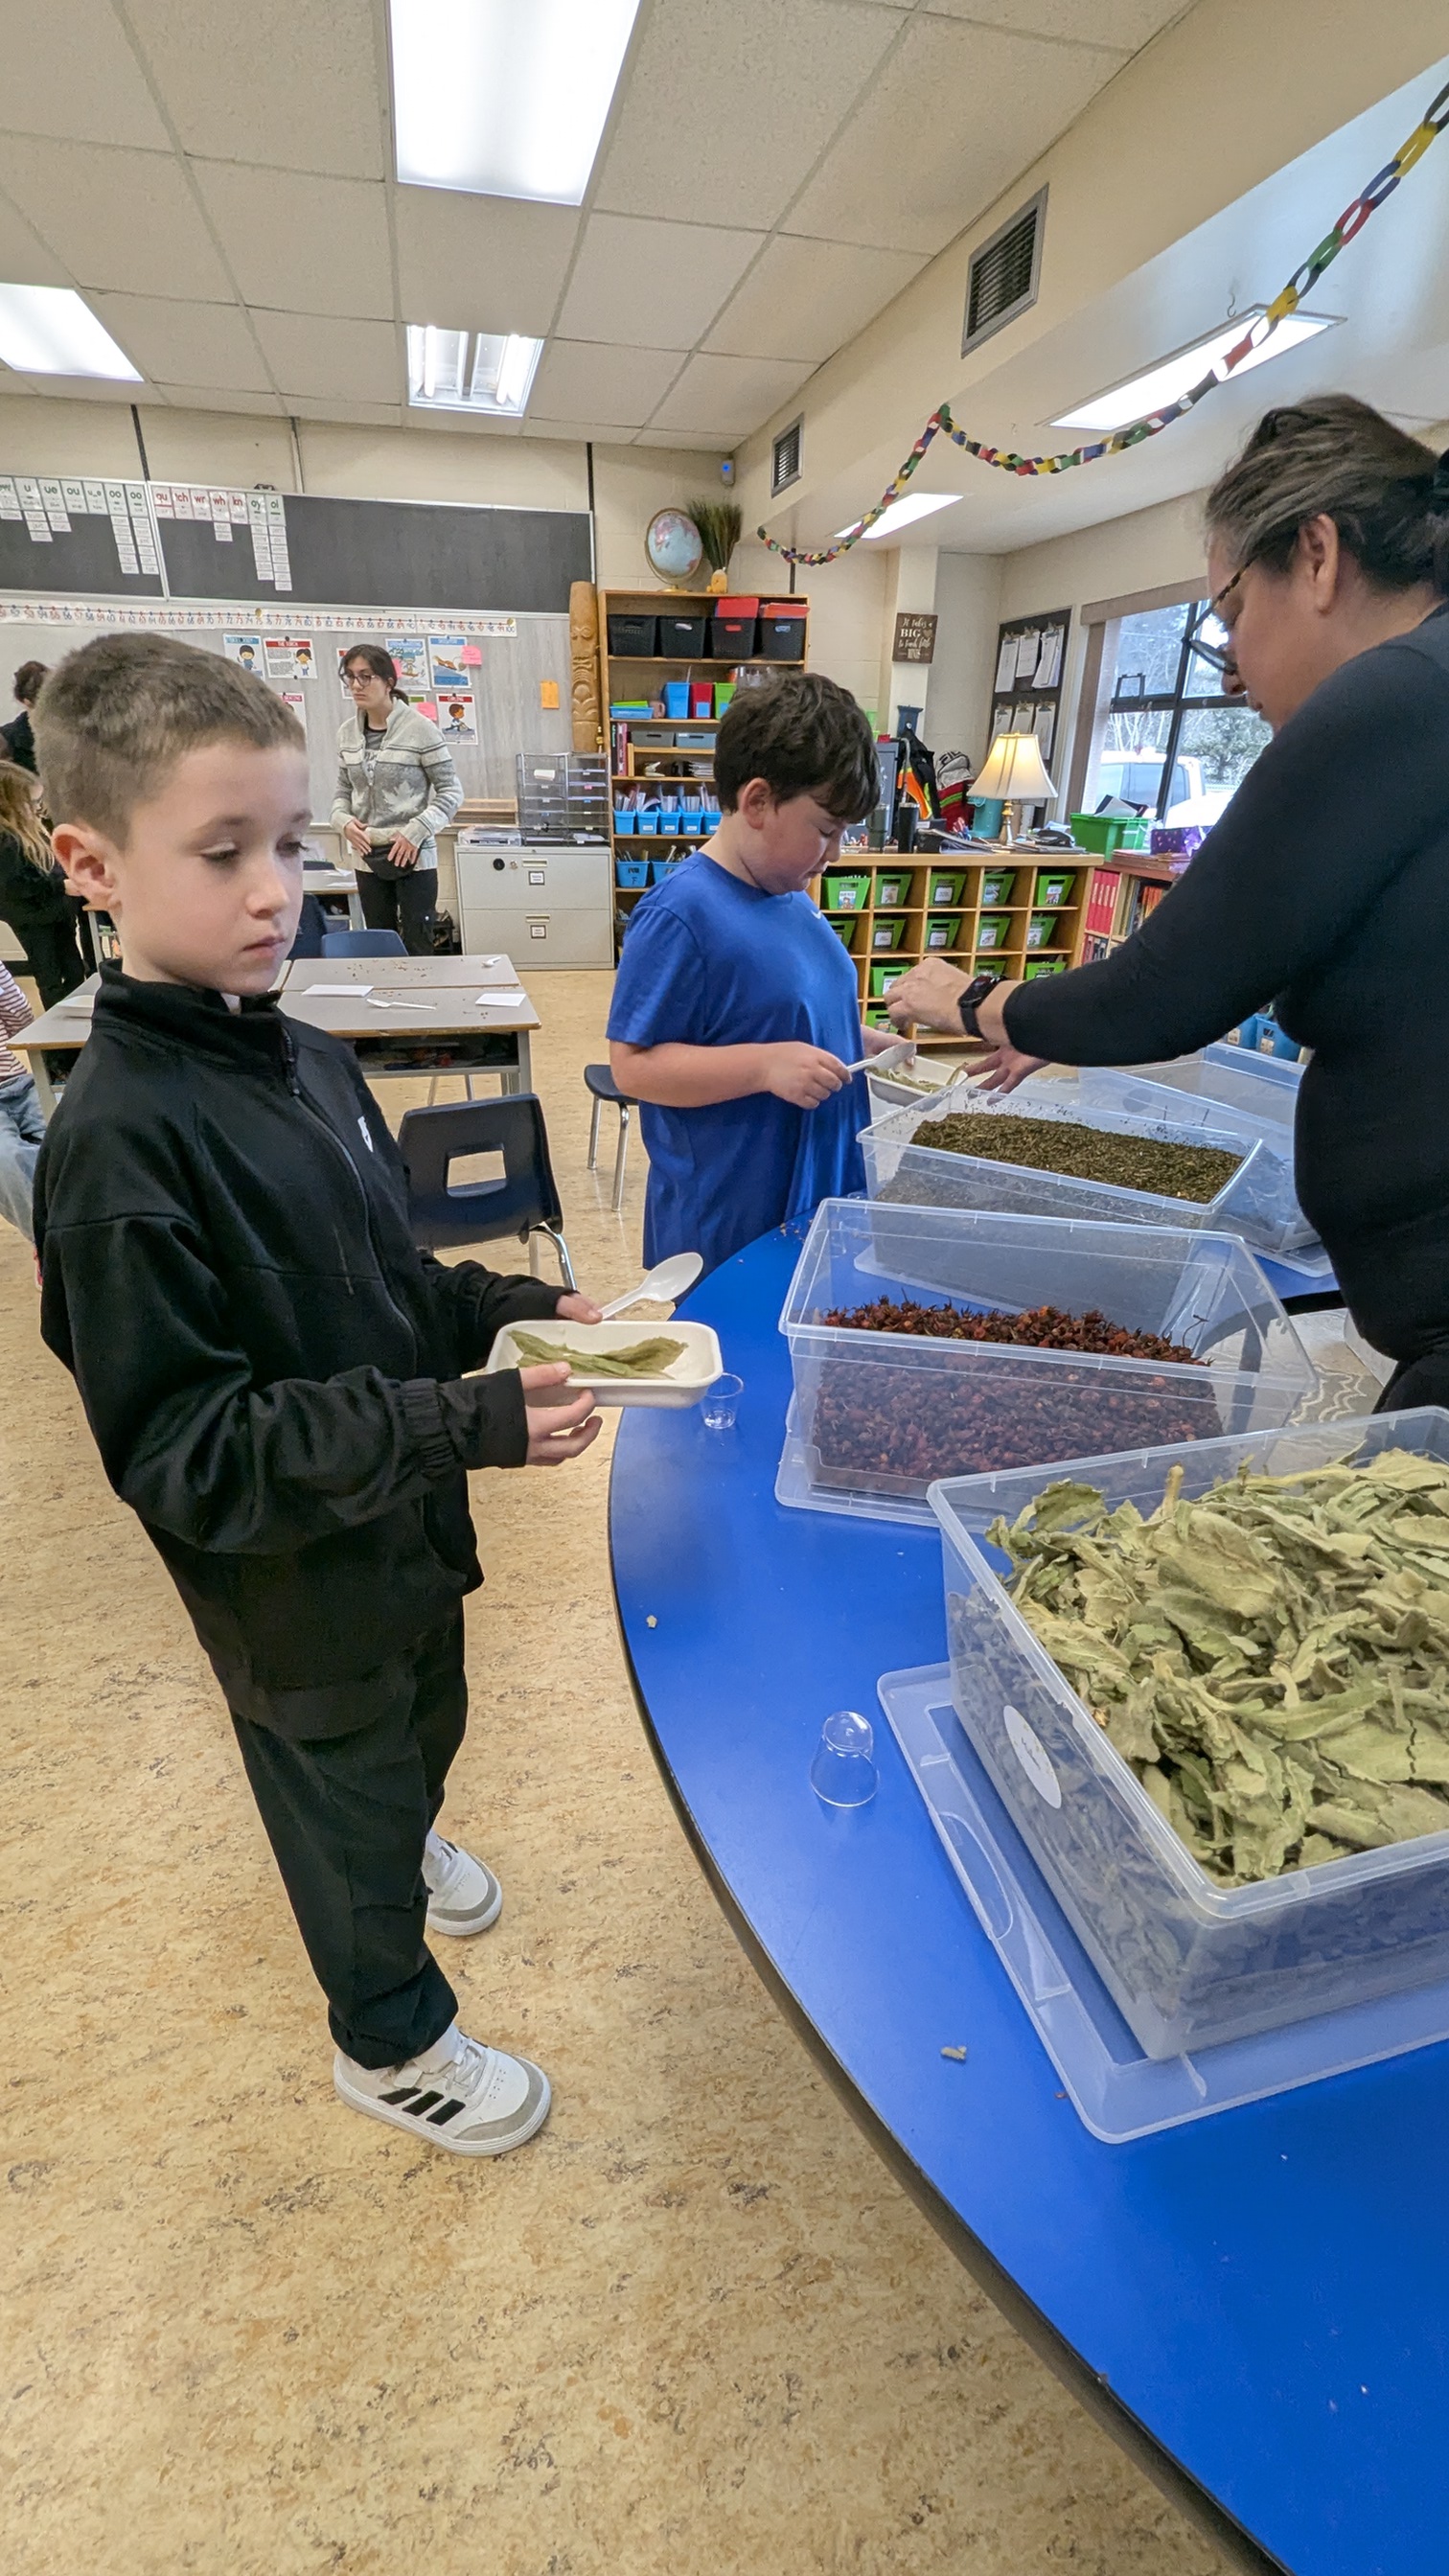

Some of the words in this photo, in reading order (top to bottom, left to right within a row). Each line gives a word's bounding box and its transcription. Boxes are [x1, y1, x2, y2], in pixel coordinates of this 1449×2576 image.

[108, 490, 122, 498] oo
[129, 492, 143, 500] oo
[155, 493, 168, 503] qu
[194, 495, 206, 504] wr
[212, 495, 226, 506] wh
[233, 496, 243, 507] kn
[250, 499, 262, 511] oy
[901, 628, 921, 638] BIG
